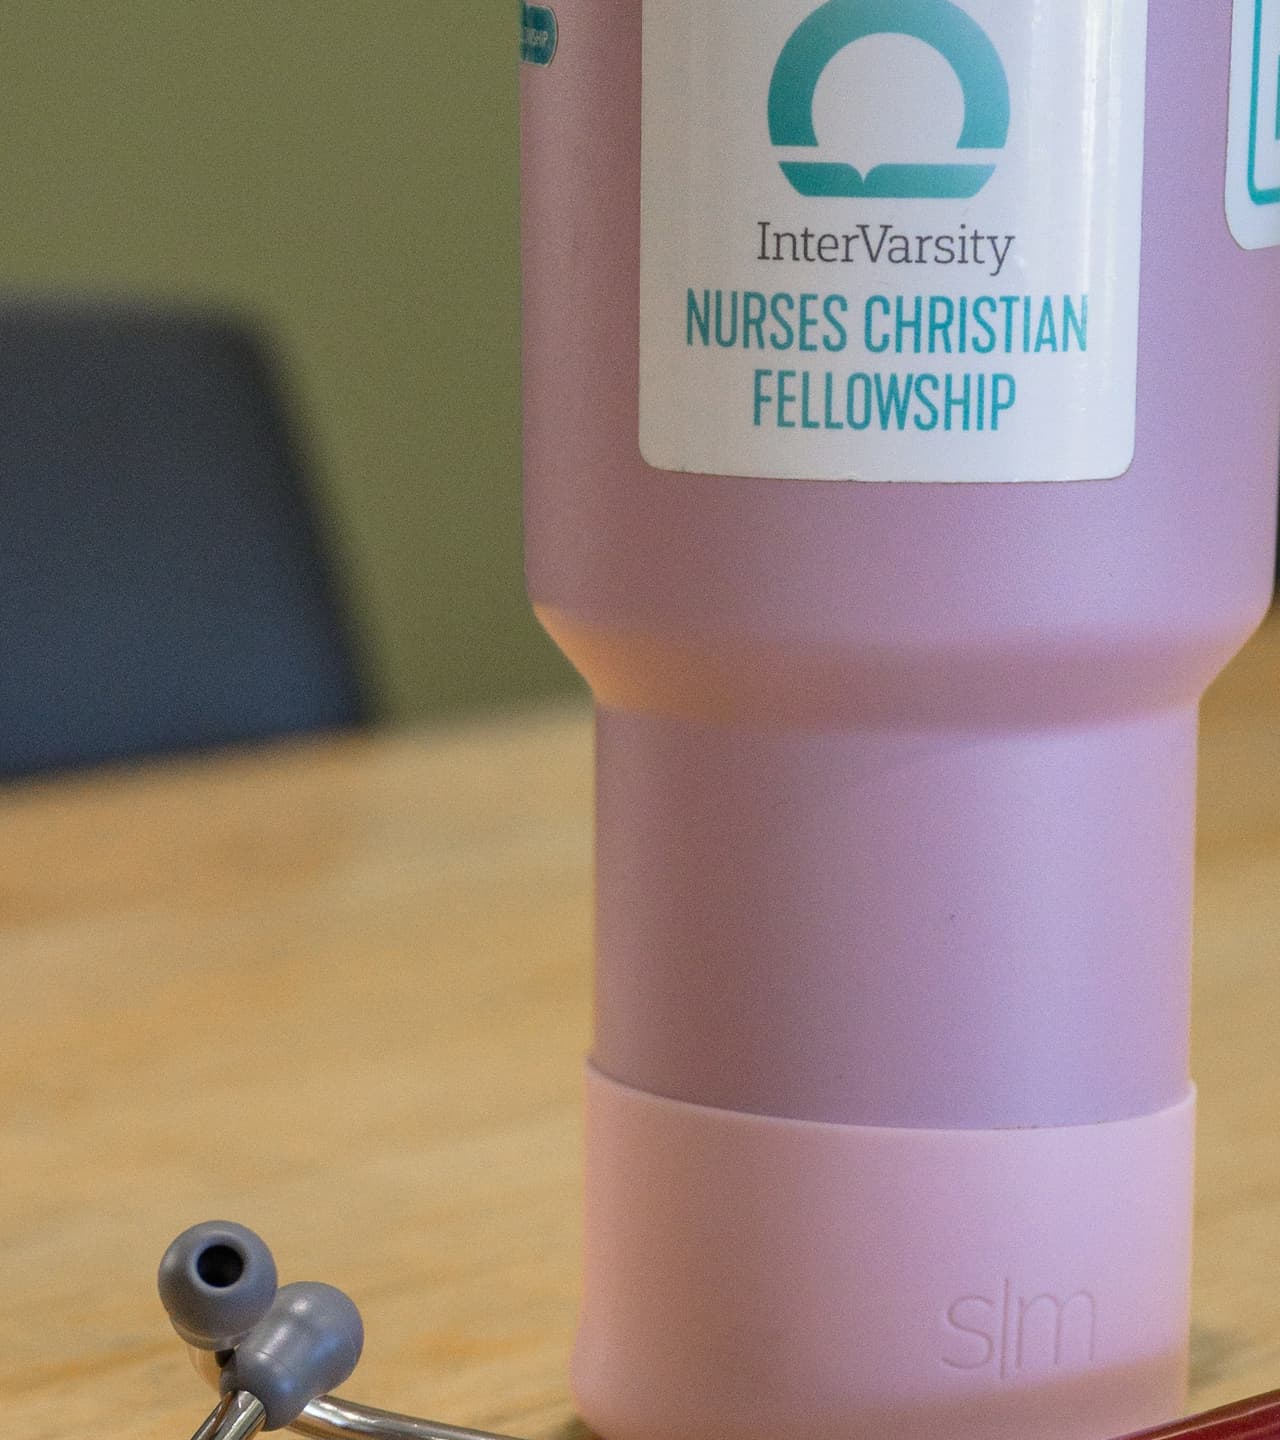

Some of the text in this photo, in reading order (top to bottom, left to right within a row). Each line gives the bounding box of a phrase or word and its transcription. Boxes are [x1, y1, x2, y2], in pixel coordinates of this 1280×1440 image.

[756, 221, 1016, 277] InterVarsity
[685, 287, 1089, 355] NURSES CHRISTIAN
[752, 368, 1017, 433] FELLOWSHIP
